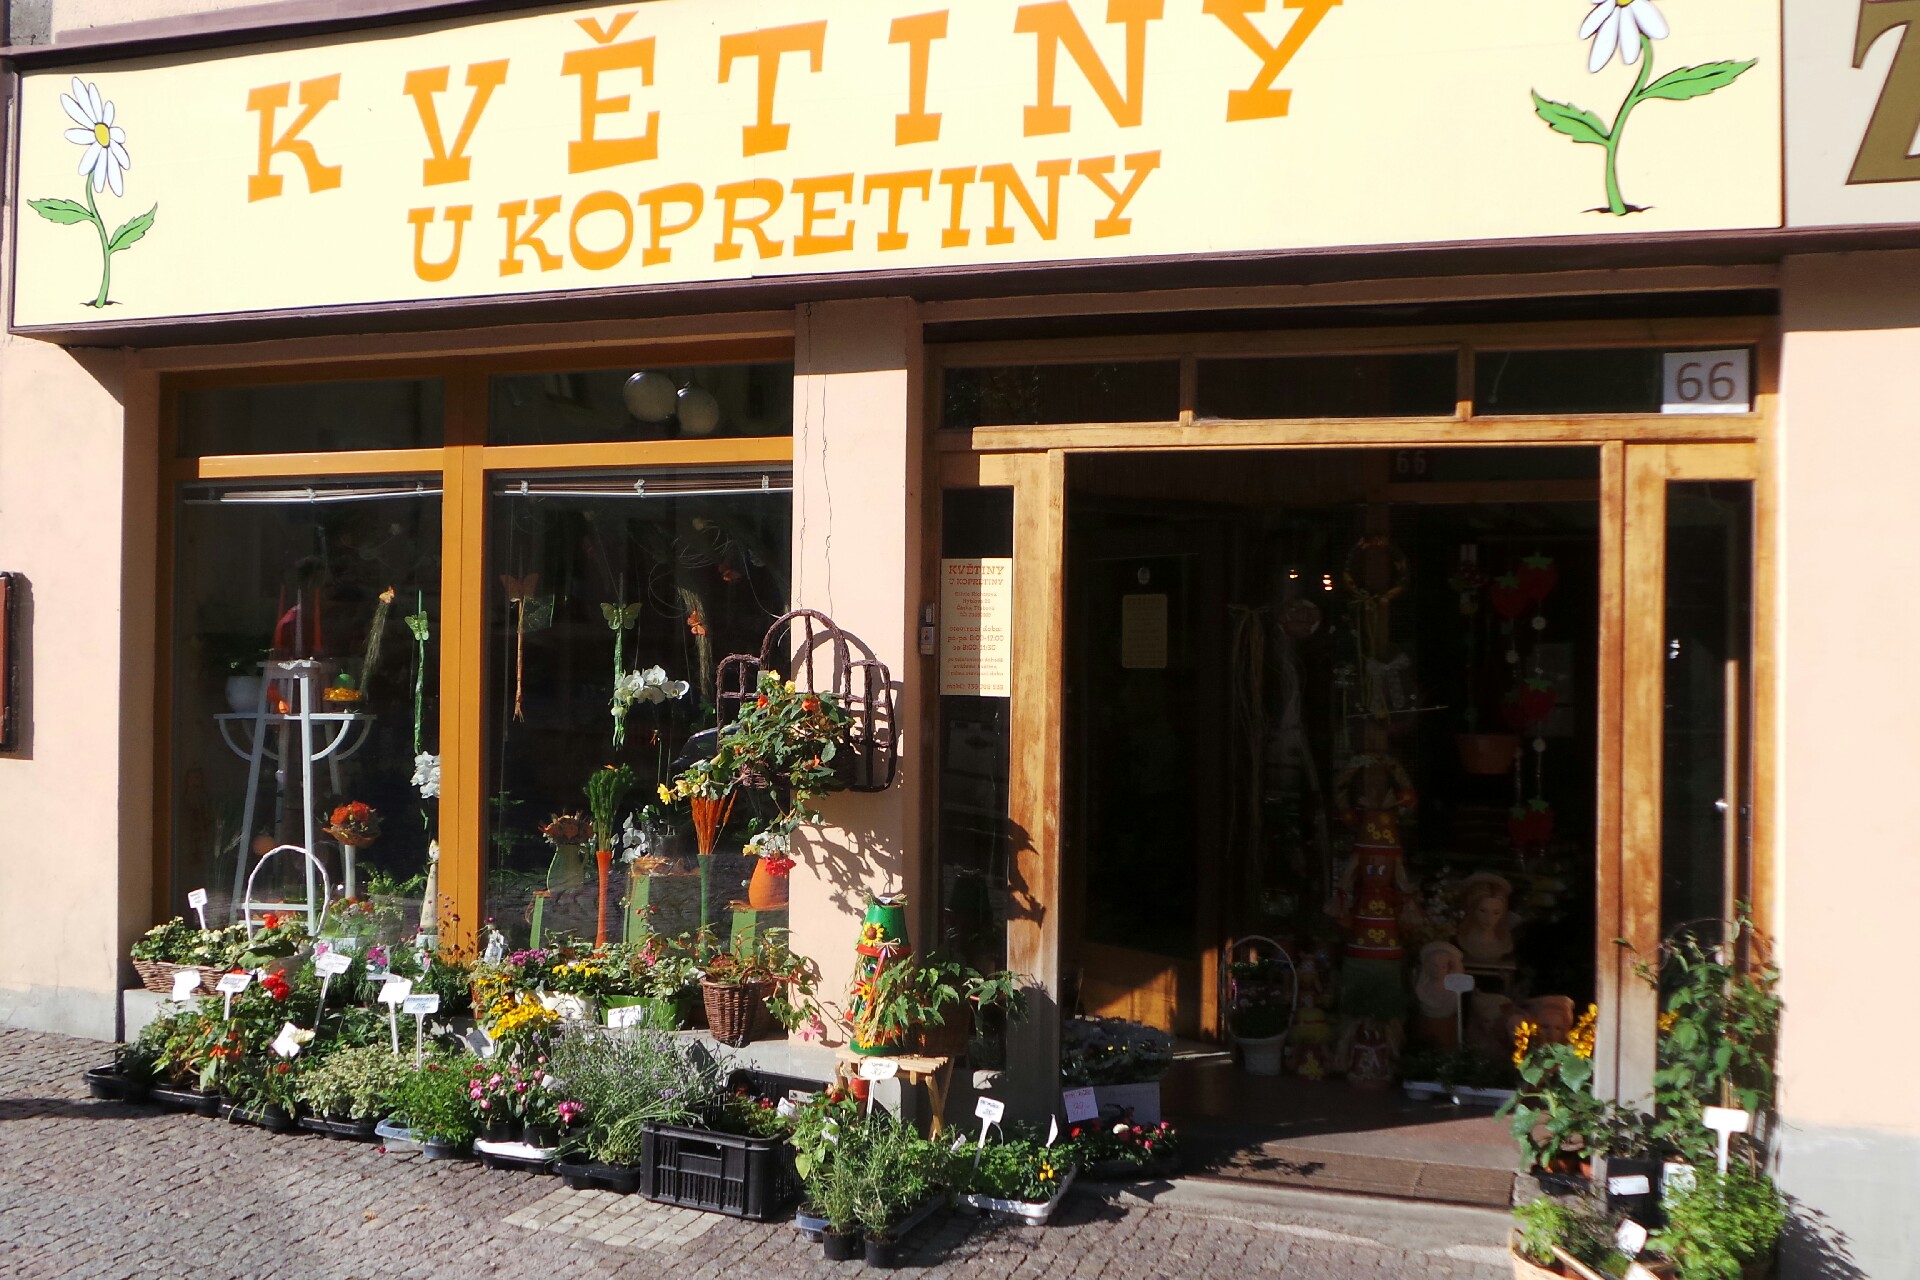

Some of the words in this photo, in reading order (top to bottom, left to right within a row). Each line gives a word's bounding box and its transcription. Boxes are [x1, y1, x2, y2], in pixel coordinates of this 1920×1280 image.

[407, 205, 473, 283] U
[498, 150, 1162, 277] KOPRETINY
[1677, 361, 1735, 402] 66
